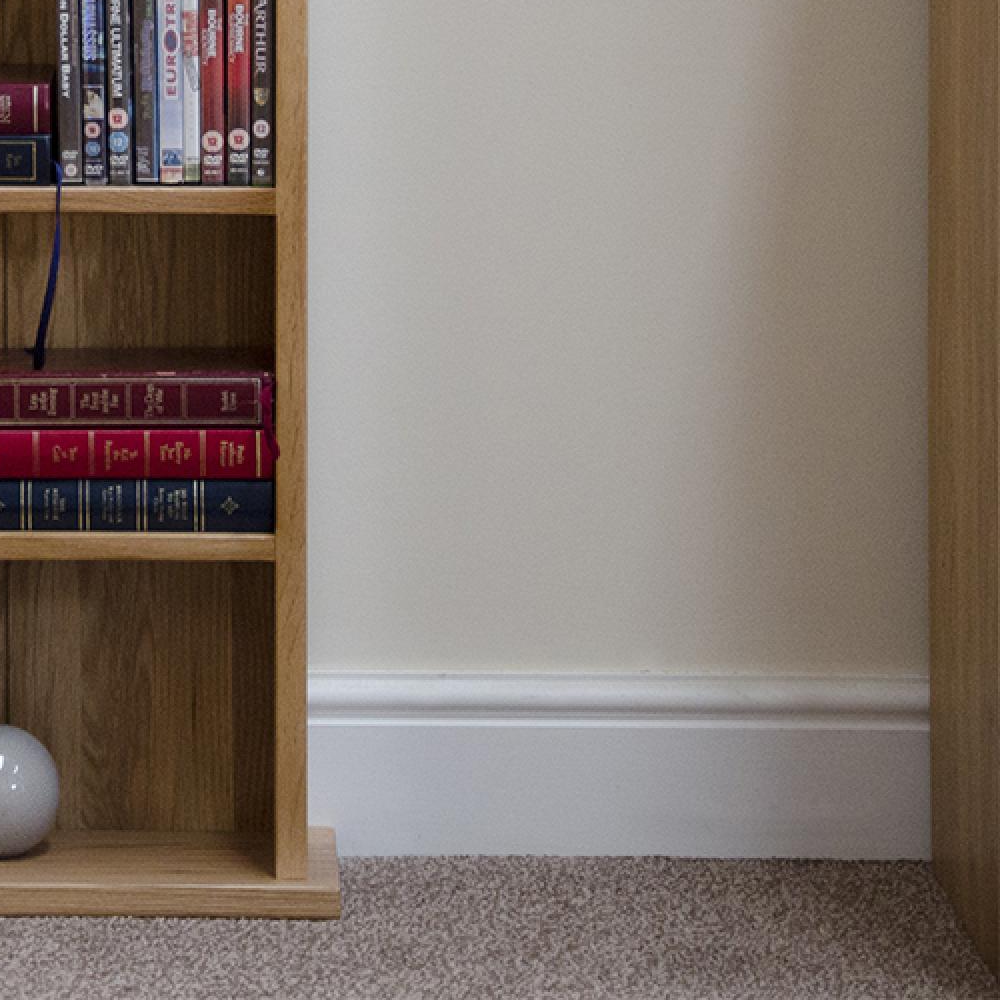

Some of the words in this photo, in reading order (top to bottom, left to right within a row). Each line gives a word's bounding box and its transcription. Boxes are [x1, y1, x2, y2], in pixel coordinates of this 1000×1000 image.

[59, 13, 69, 61] DOLLAR
[207, 8, 217, 57] BOURNE
[234, 3, 245, 52] BOURNE
[60, 63, 71, 99] BABY
[110, 29, 123, 98] ULTIMATUM
